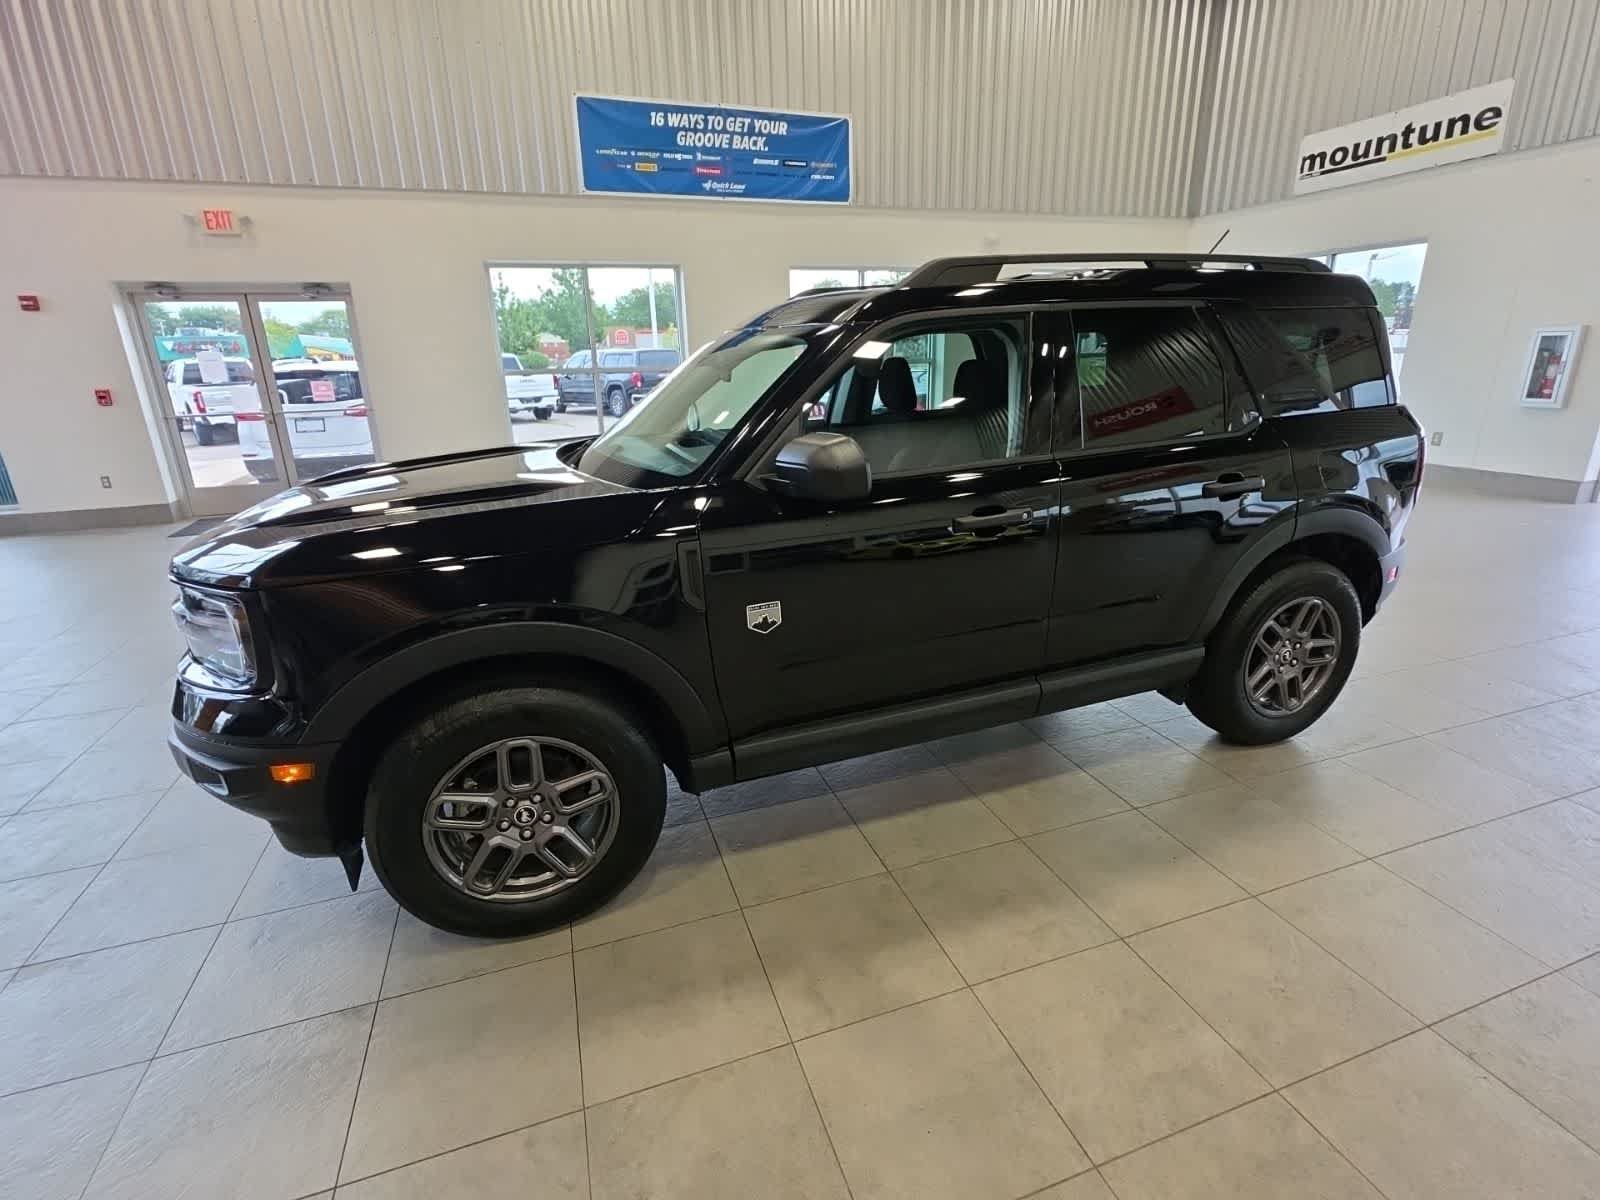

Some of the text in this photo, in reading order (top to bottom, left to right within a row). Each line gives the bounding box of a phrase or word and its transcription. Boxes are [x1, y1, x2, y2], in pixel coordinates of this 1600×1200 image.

[650, 112, 788, 135] 16 WAYS TO GET YOUR
[677, 131, 769, 151] GROOVE BACK.
[1300, 106, 1503, 175] mountune
[203, 210, 232, 231] EXIT
